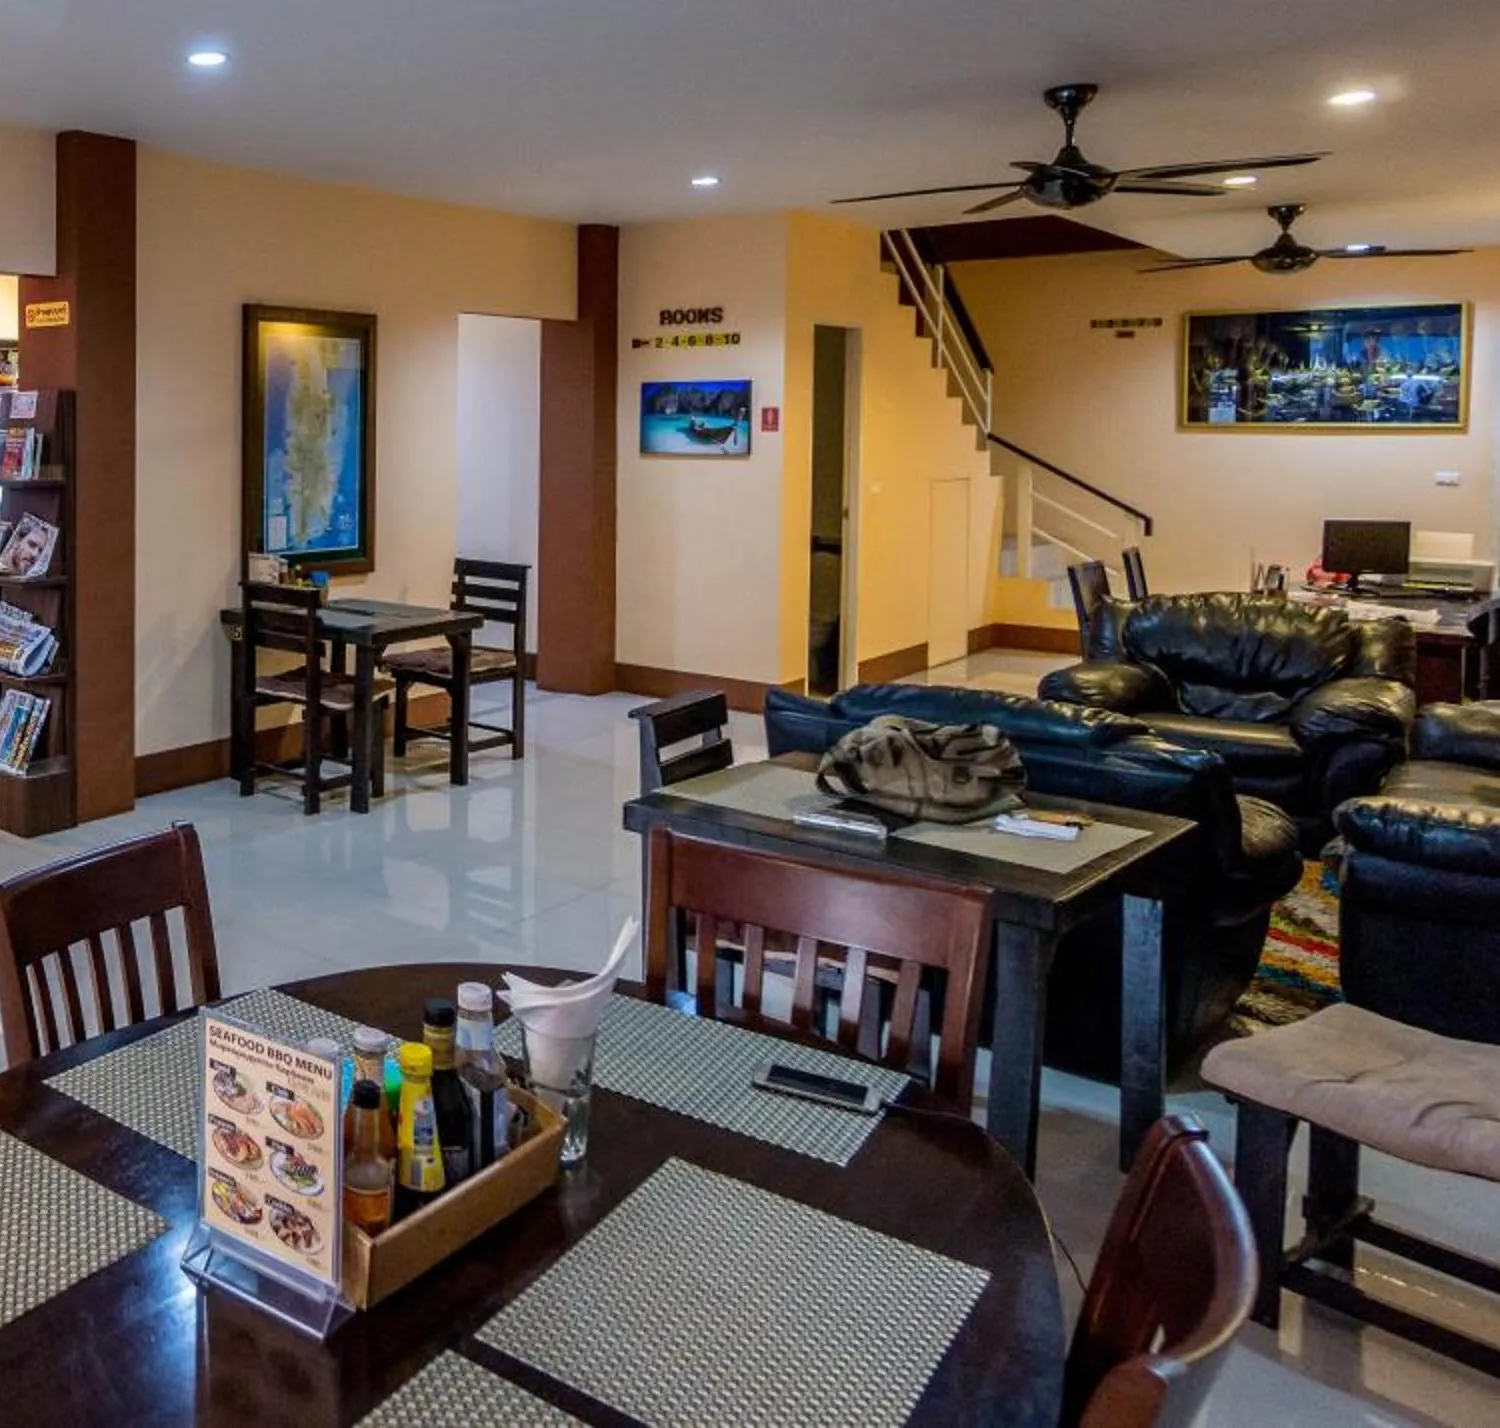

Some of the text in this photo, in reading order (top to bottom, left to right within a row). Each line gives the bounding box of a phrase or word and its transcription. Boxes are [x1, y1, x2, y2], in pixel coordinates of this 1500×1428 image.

[659, 306, 724, 326] ROOMS
[209, 1025, 333, 1081] SEAFOOD BBQ MENU
